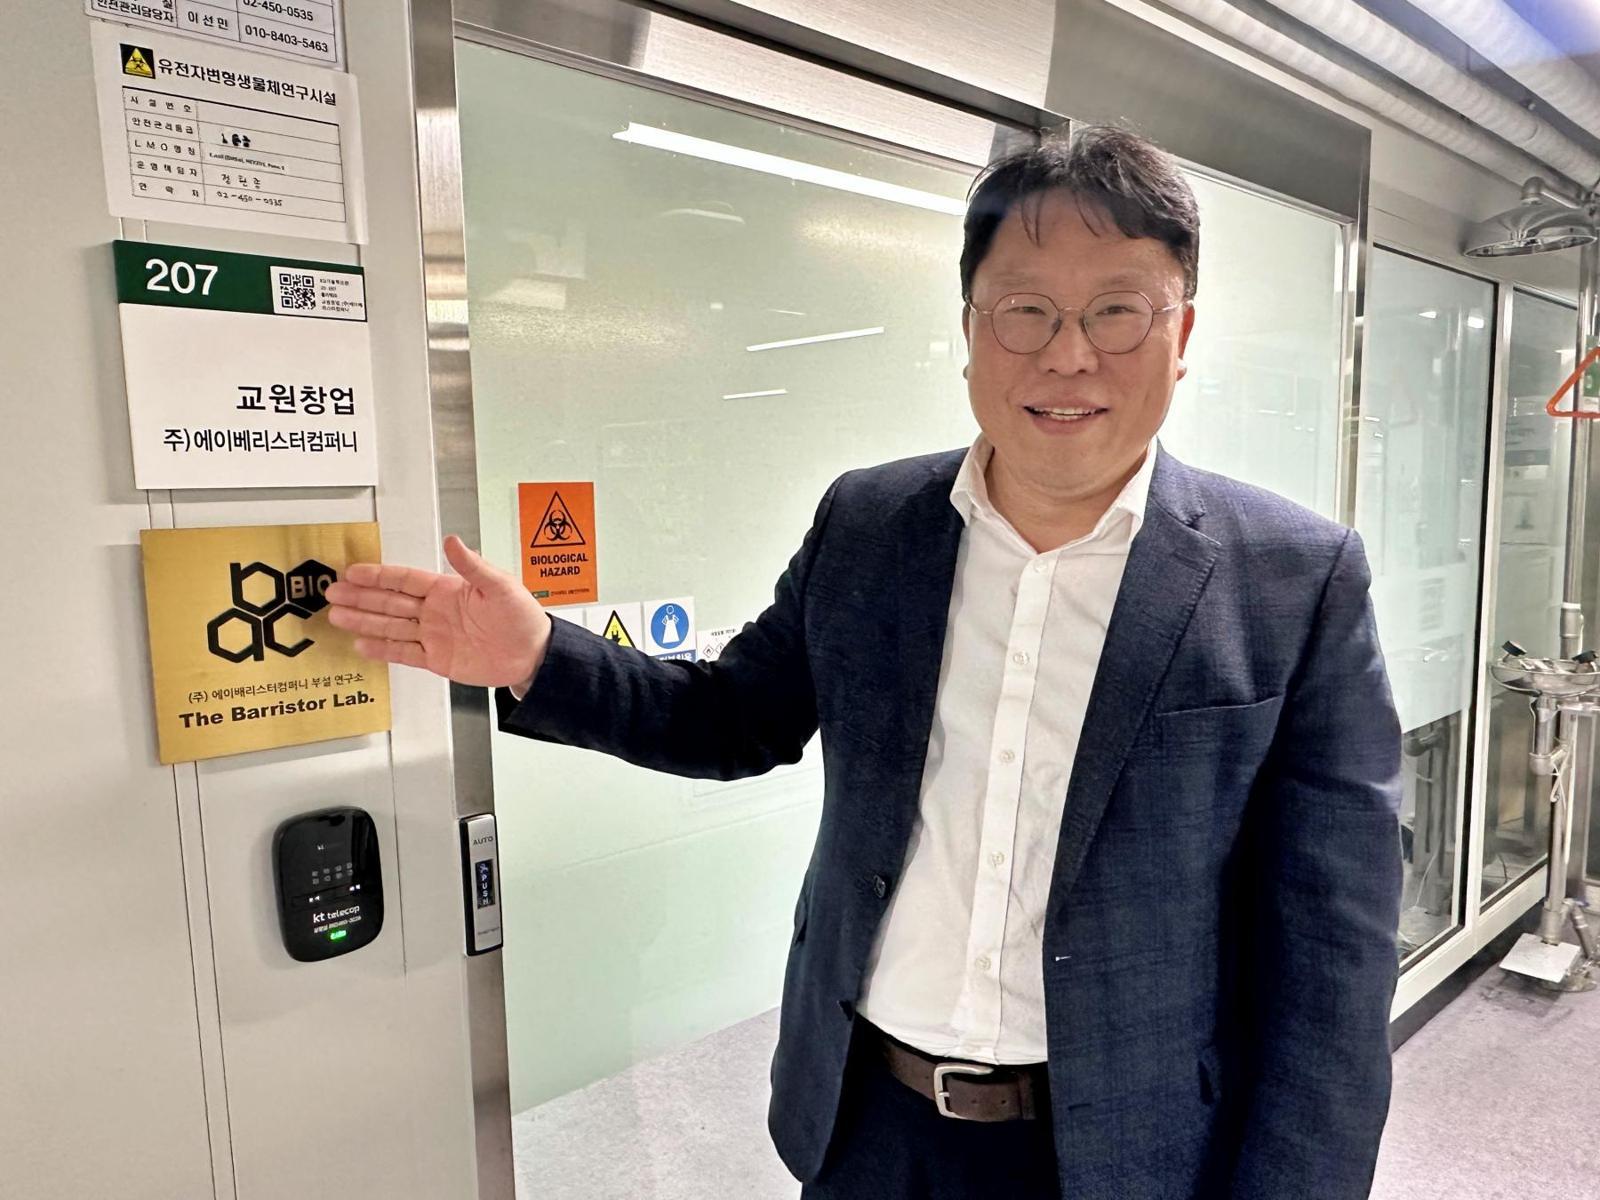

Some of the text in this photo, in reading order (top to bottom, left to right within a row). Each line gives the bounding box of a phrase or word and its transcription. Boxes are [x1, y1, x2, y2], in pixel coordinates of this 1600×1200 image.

[244, 24, 329, 53] 010-8403-5463
[158, 58, 337, 107] 유전자변형생물체연구시설
[145, 258, 218, 295] 207
[236, 384, 355, 415] 교원창업
[530, 553, 589, 565] BIOLOGICAL
[540, 566, 581, 577] HAZARD
[312, 676, 331, 688] 부설
[334, 673, 365, 686] 연구소
[179, 690, 375, 728] The Barristor Lab.
[473, 835, 494, 846] AUTO
[481, 874, 489, 905] PUSH
[313, 905, 360, 923] kt telecop
